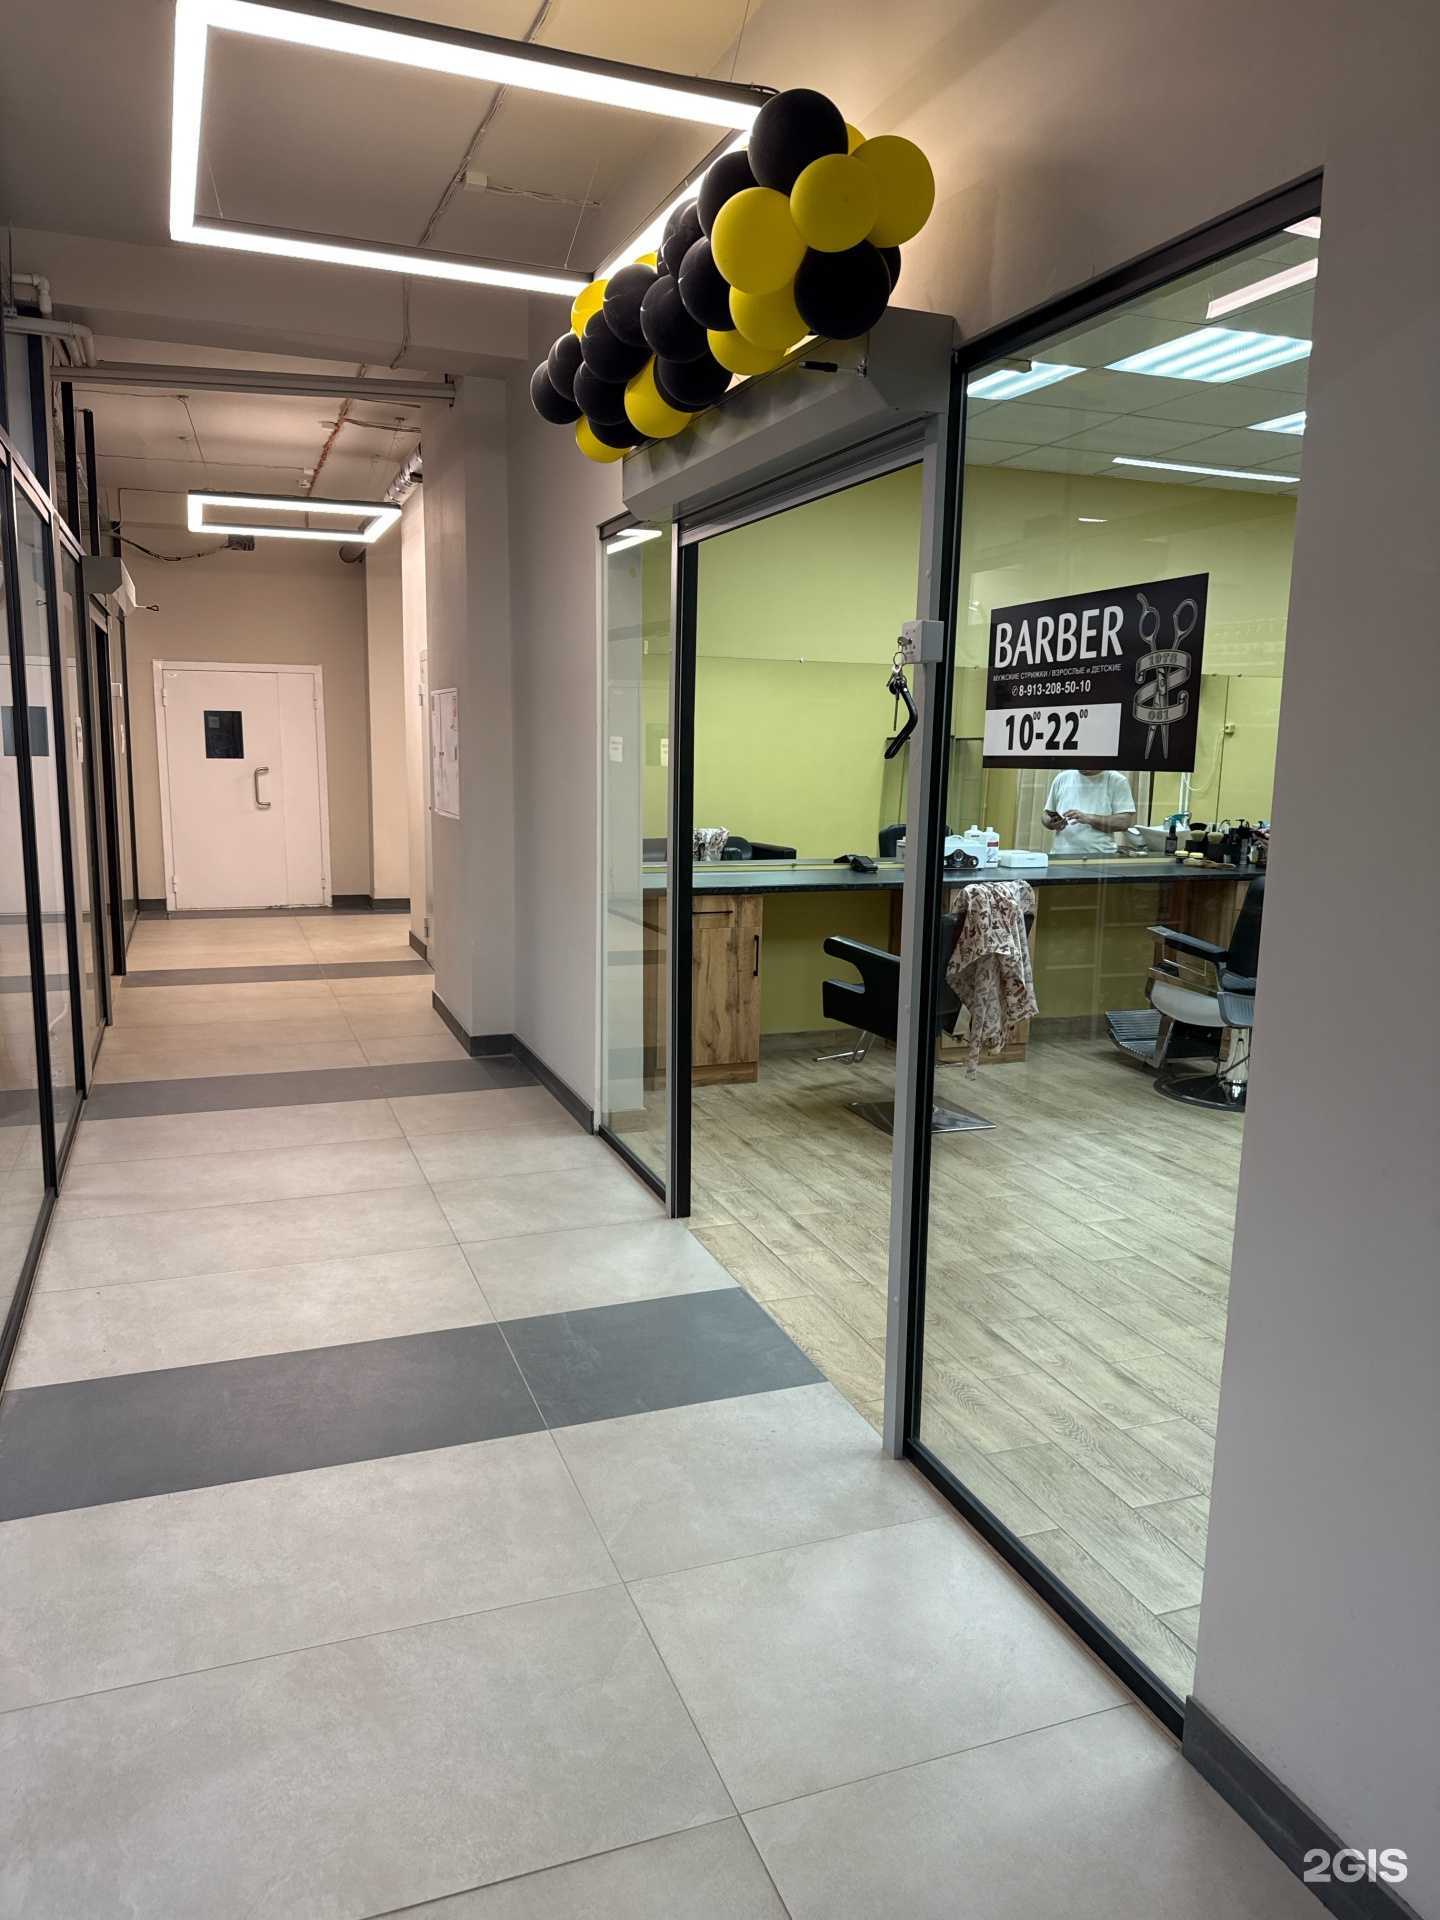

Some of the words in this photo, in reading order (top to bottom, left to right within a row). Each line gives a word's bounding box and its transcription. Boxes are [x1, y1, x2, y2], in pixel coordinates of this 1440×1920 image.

[994, 605, 1124, 668] BARBER
[1052, 666, 1086, 677] ВЗРОСЛЫЕ
[1091, 663, 1122, 674] ДЕТСКИЕ
[1019, 680, 1091, 696] 8-913-208-50-10
